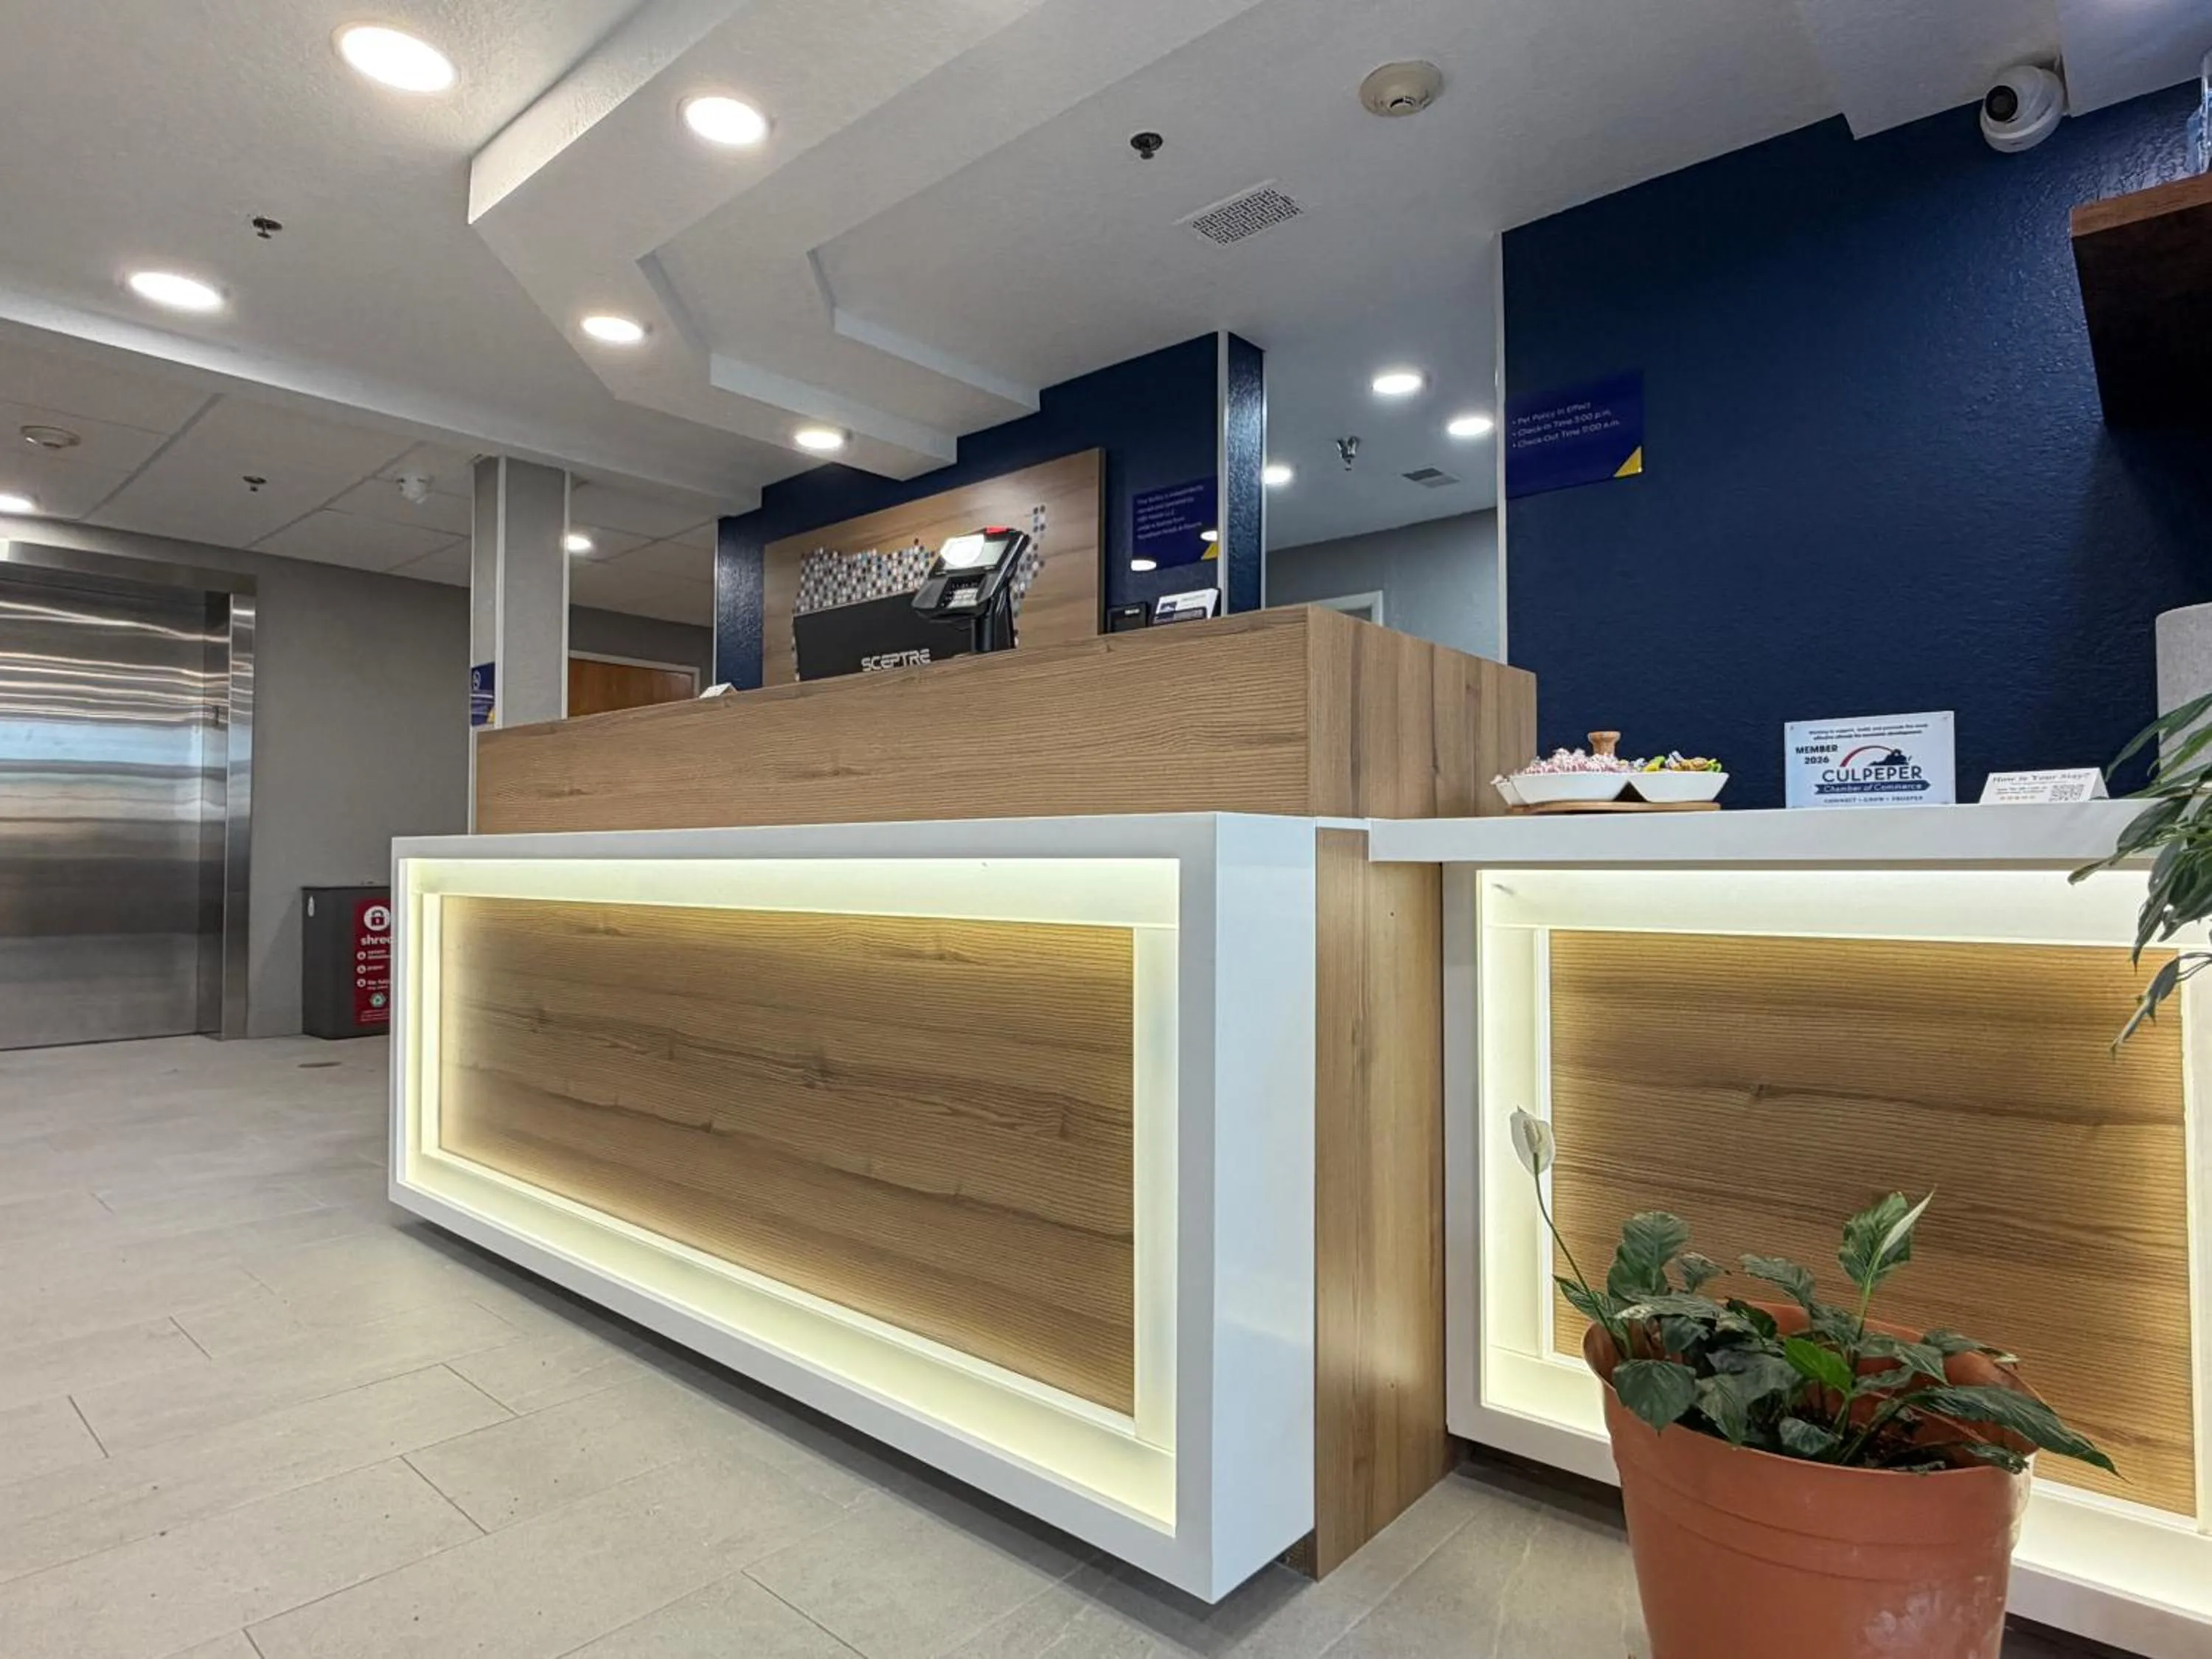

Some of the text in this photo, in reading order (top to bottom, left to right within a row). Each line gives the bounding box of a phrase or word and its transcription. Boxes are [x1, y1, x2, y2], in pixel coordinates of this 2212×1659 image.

[1553, 419, 1573, 428] Time
[1562, 428, 1580, 437] Time
[860, 648, 931, 672] SCEPTRE
[1795, 744, 1838, 754] MEMBER
[1804, 756, 1829, 765] 2026
[1822, 765, 1922, 782] CULPEPER
[1823, 782, 1922, 793] Chamber of Commerce
